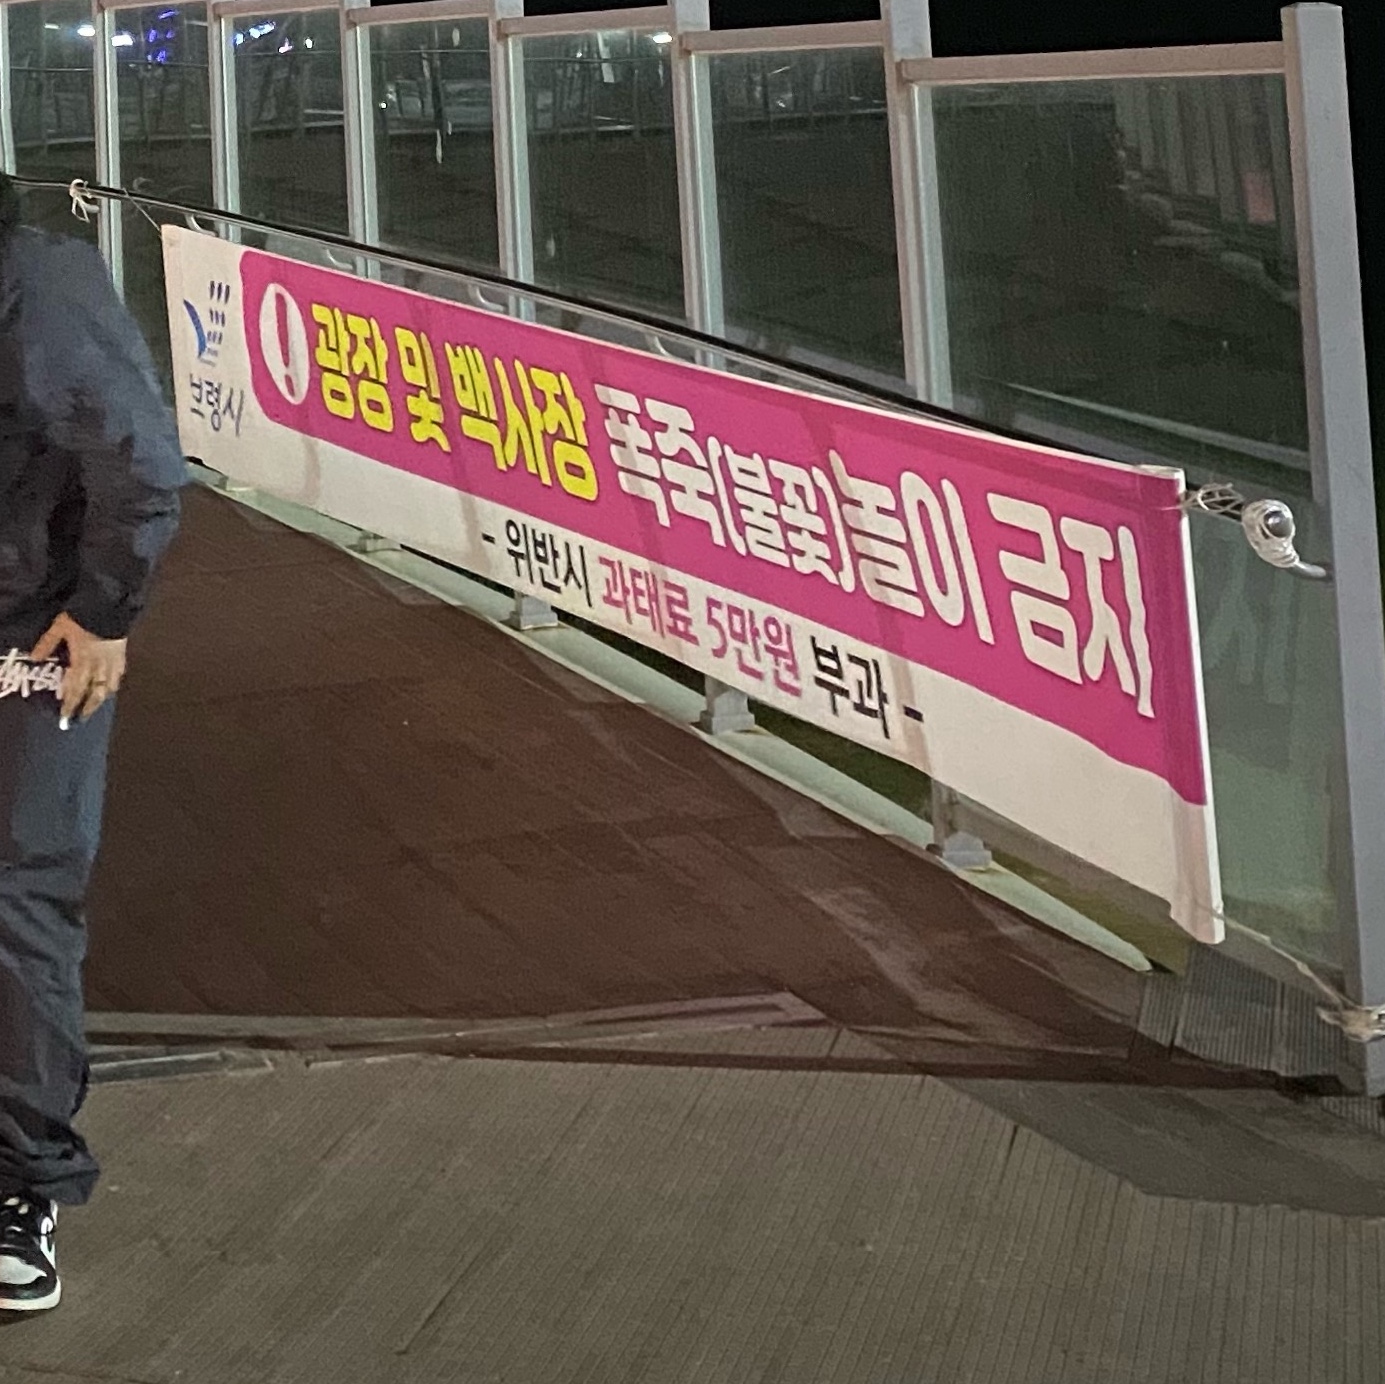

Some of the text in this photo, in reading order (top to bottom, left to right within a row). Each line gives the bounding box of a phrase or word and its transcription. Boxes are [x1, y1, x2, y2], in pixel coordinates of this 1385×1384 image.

[189, 372, 245, 438] 보령시
[311, 303, 1155, 718] 광장 및 백사장 폭죽(불꽃)놀이 금지
[505, 518, 593, 609] 위반시
[598, 555, 700, 647] 과태료
[706, 596, 803, 698] 5만원
[810, 634, 891, 740] 부과
